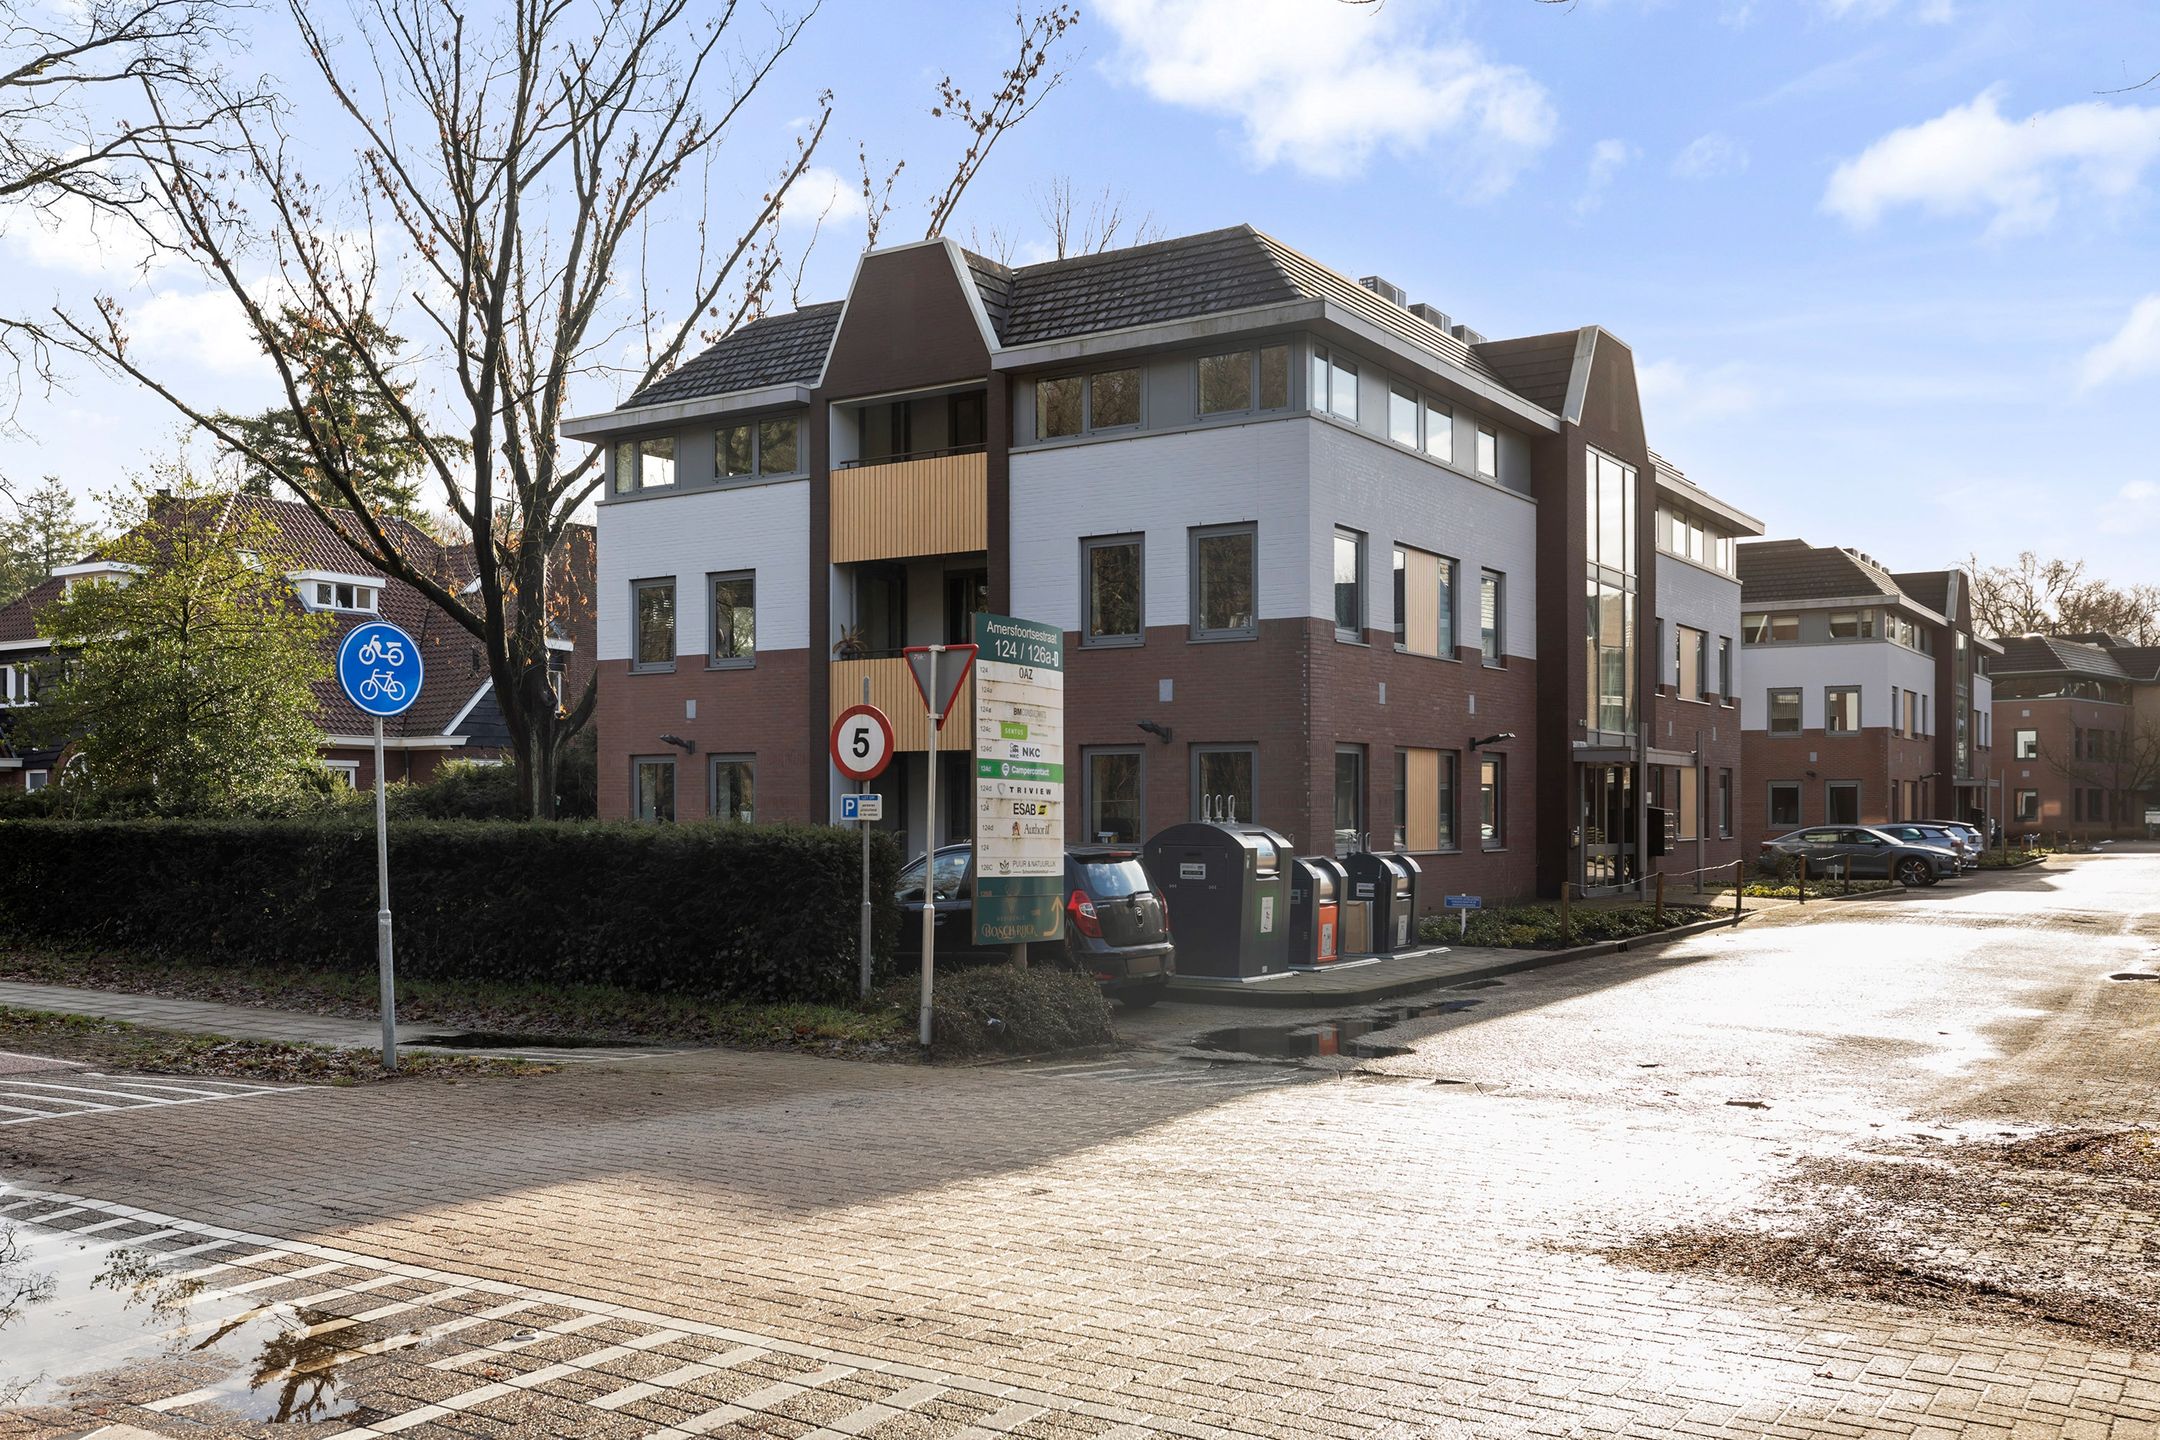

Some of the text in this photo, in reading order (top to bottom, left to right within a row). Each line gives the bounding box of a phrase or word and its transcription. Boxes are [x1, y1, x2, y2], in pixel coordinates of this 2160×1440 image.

[986, 620, 1057, 645] Amersfoortsestraat
[994, 639, 1017, 658] 124
[980, 666, 1033, 680] 124 OAZ
[853, 728, 869, 758] 5
[1022, 746, 1041, 758] NKC
[1012, 766, 1050, 777] Campercontact
[1009, 786, 1051, 795] TRIVIEW
[845, 800, 855, 816] P
[1013, 803, 1036, 816] ESAB
[1012, 860, 1027, 868] PUUR
